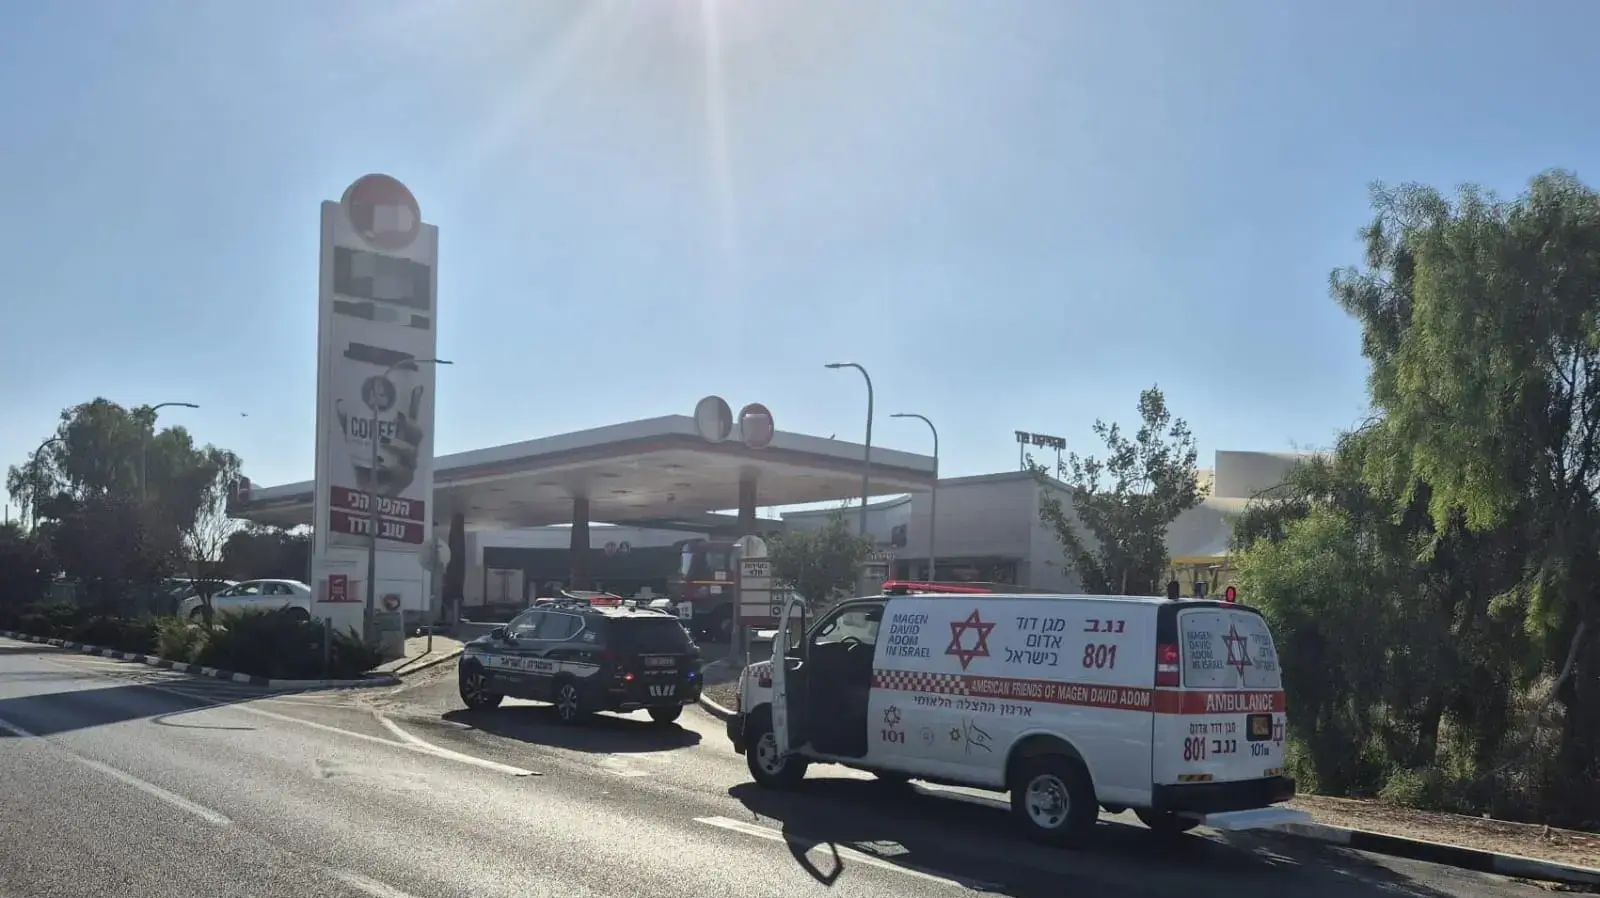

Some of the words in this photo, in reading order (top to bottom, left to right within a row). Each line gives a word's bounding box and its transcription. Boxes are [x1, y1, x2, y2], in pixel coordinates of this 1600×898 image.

[348, 492, 369, 510] הכי
[382, 521, 405, 538] טוב
[892, 613, 929, 624] MAGEN
[1016, 616, 1038, 630] דוד
[1040, 617, 1066, 632] מגן
[890, 624, 920, 634] DAVID
[1083, 619, 1125, 633] נגב
[888, 634, 919, 645] ADOM
[1026, 634, 1062, 649] אדום
[886, 646, 897, 656] IN
[898, 646, 930, 658] ISRAEL
[1004, 647, 1058, 666] בישראל
[1082, 644, 1117, 669] 801
[971, 680, 1010, 696] AMERICAN
[1011, 683, 1042, 697] FRIENDS
[1044, 687, 1057, 698] OF
[1058, 687, 1088, 701] MAGEN
[1091, 690, 1117, 703] DAVID
[1120, 692, 1151, 706] ADOM
[913, 694, 952, 708] הלאומי
[957, 700, 996, 713] ההצלה
[1206, 694, 1273, 711] AMBULANCE
[1000, 704, 1032, 717] ארגון
[1189, 723, 1208, 734] אדום
[1209, 723, 1222, 733] דוד
[1224, 722, 1236, 734] מגן
[881, 729, 904, 744] 101
[1184, 737, 1206, 760] 801
[1212, 740, 1237, 753] נגב
[1251, 743, 1264, 756] 101
